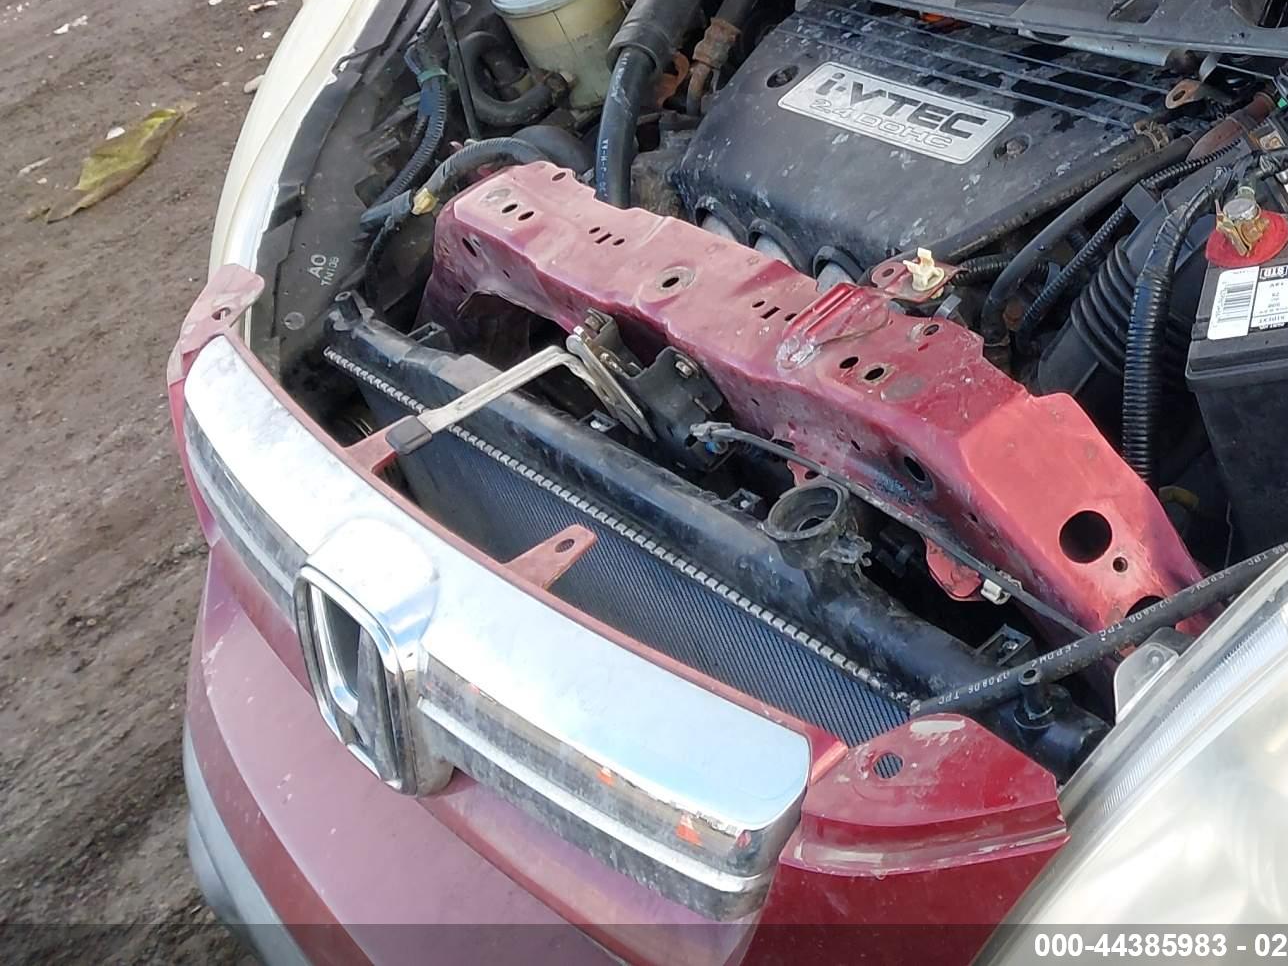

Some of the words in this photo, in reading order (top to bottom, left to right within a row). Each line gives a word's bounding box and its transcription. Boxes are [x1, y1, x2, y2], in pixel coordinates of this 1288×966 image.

[809, 98, 855, 119] 2.4
[855, 112, 954, 149] DOHC
[816, 72, 987, 139] i-VTEC
